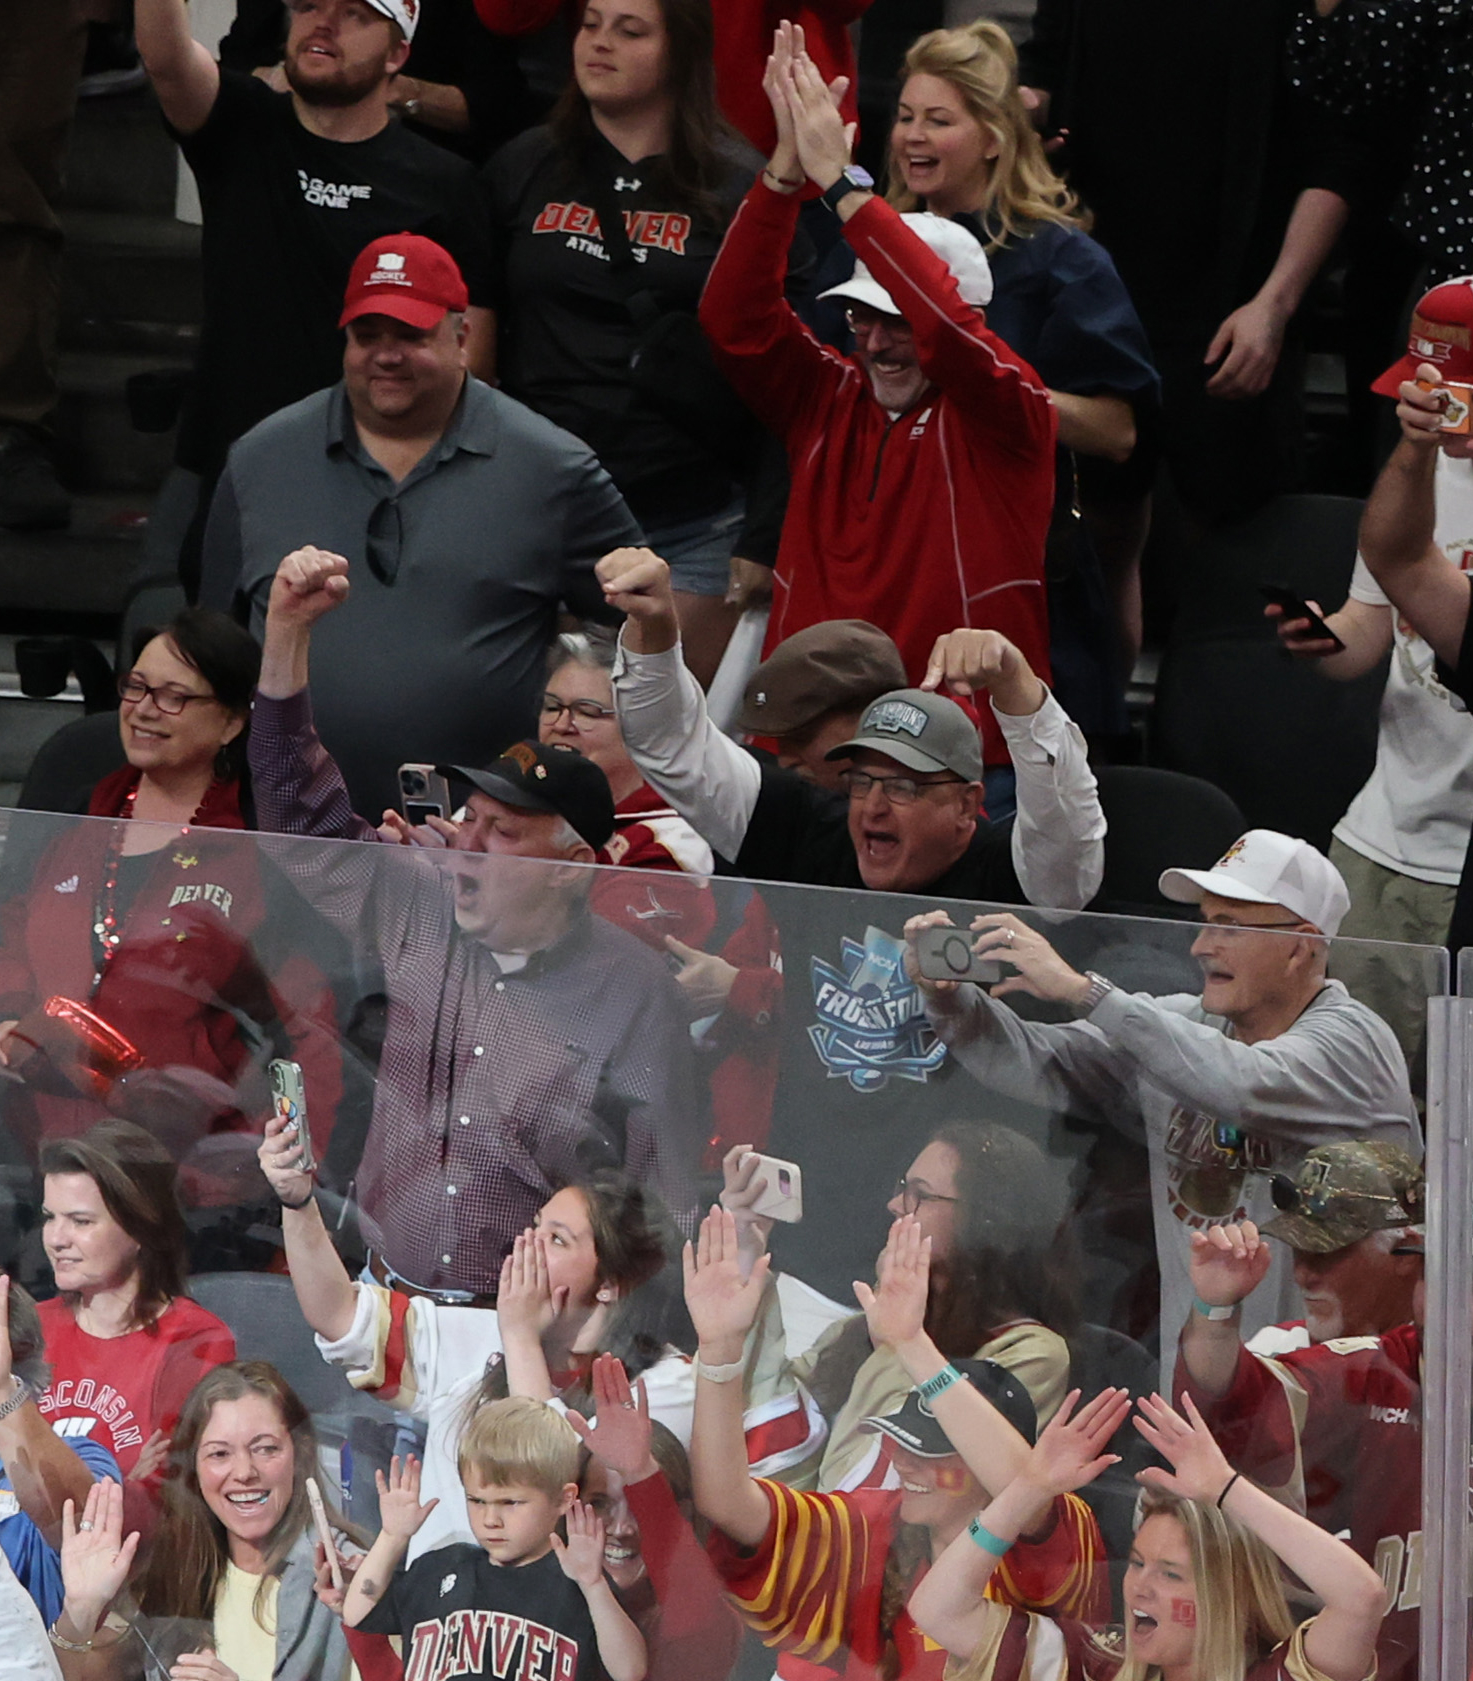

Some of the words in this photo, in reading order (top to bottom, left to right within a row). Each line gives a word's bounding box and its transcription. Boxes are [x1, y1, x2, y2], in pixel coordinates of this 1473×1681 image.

[309, 178, 372, 199] GAME
[305, 191, 350, 209] ONE
[37, 1378, 145, 1453] SCONSIN
